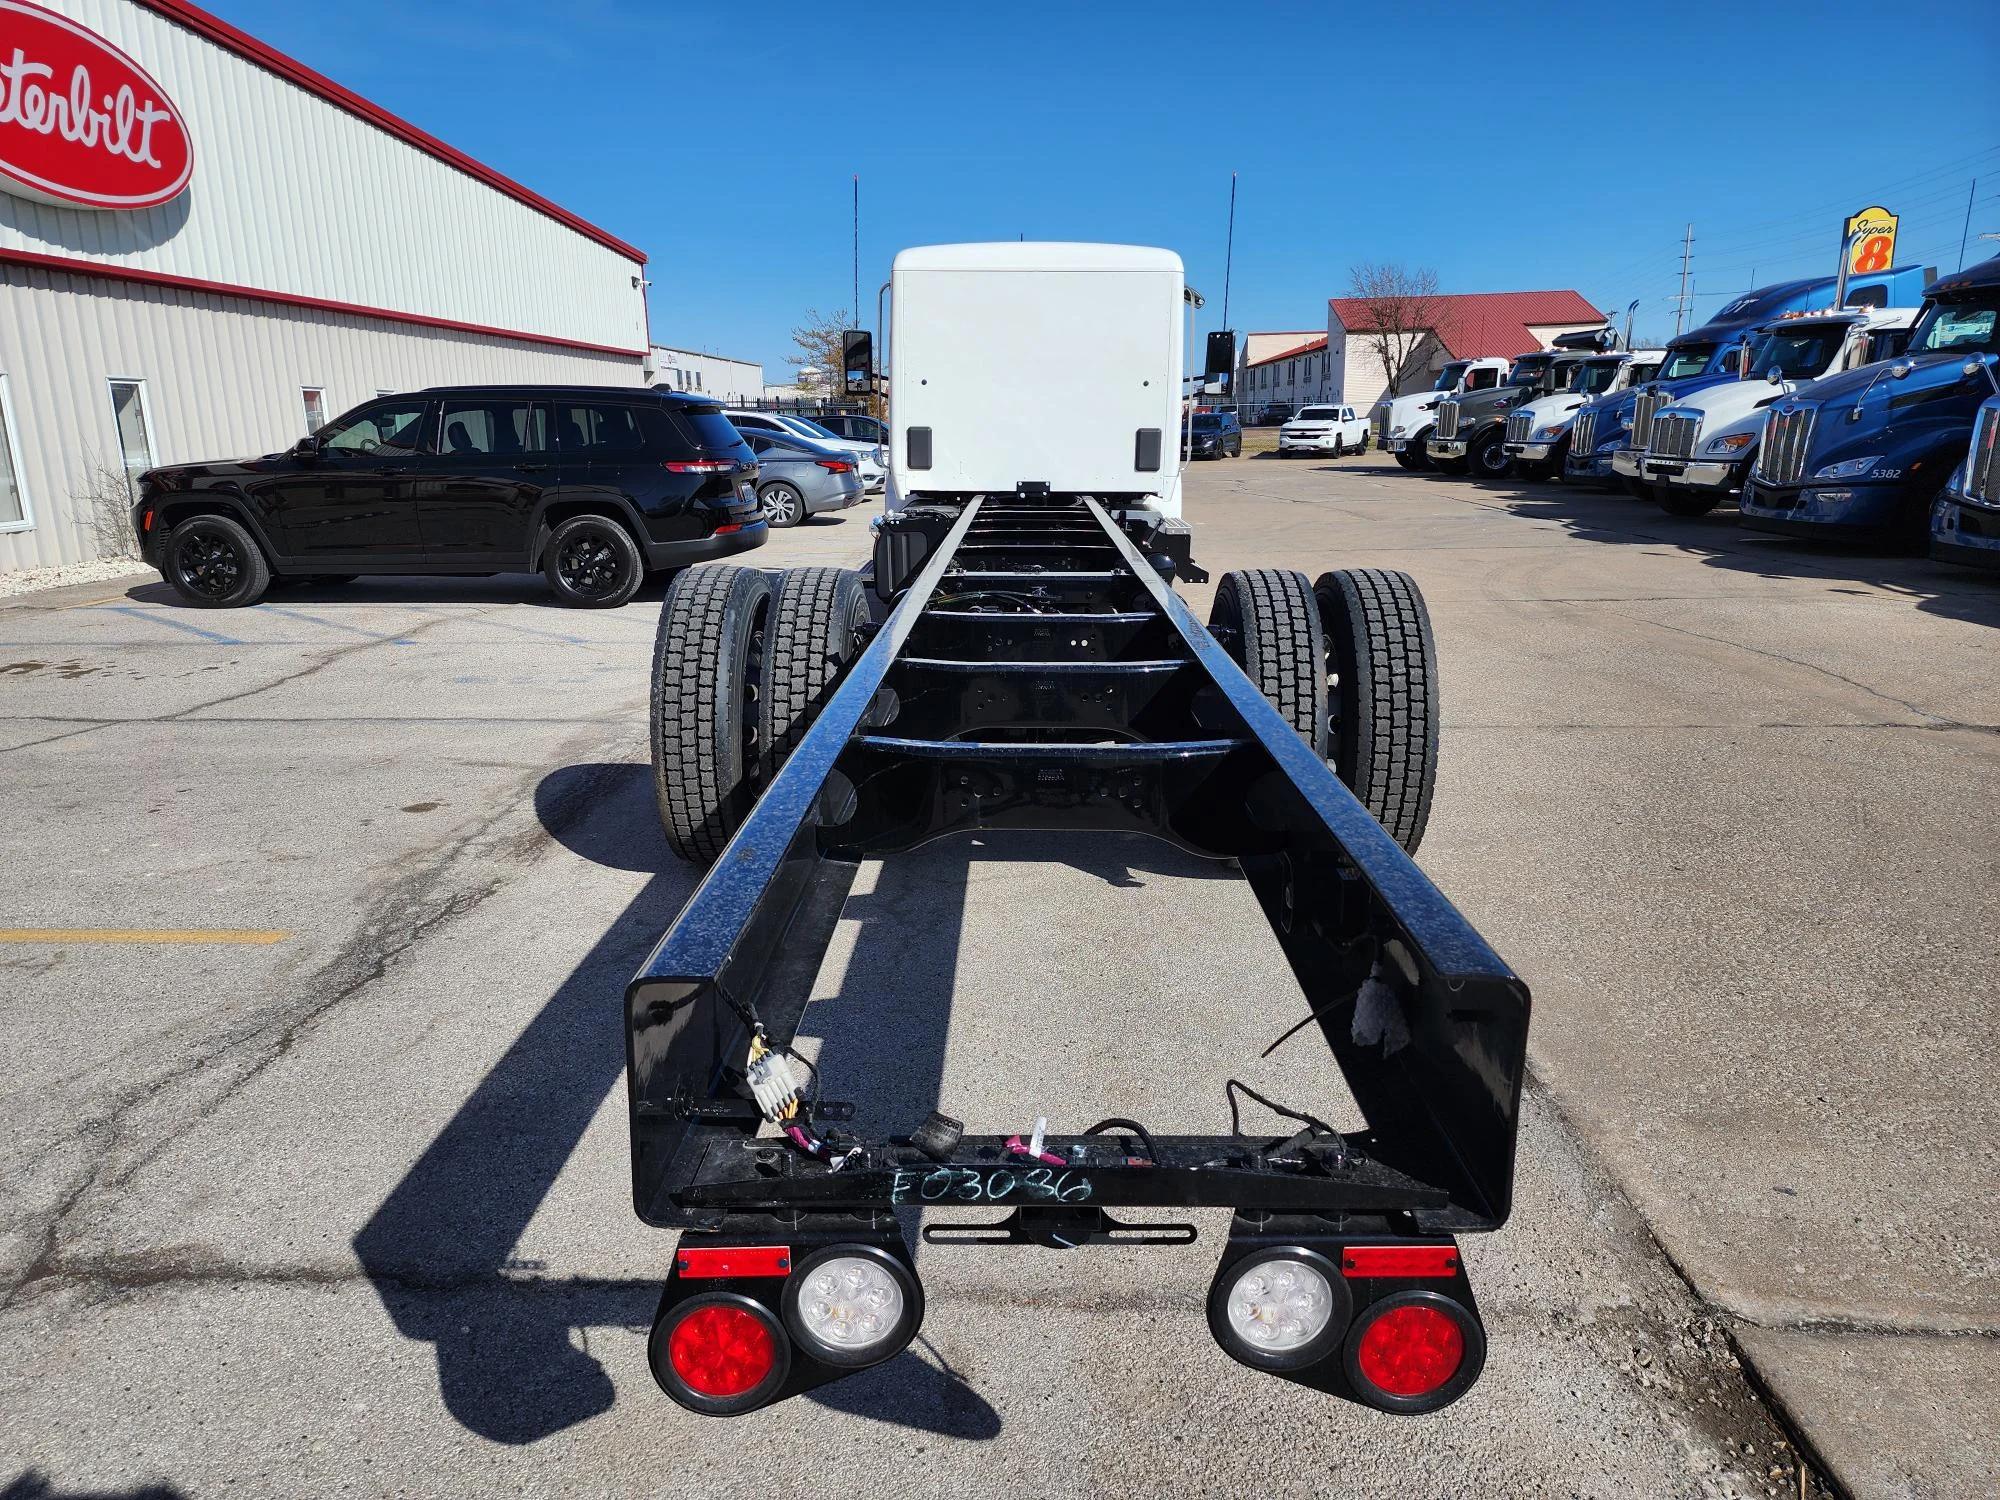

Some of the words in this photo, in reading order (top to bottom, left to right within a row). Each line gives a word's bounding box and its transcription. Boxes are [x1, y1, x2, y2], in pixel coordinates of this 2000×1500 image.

[0, 48, 171, 168] terbilt
[1852, 219, 1894, 243] Super
[1853, 235, 1892, 274] 8
[1871, 469, 1901, 479] 5382
